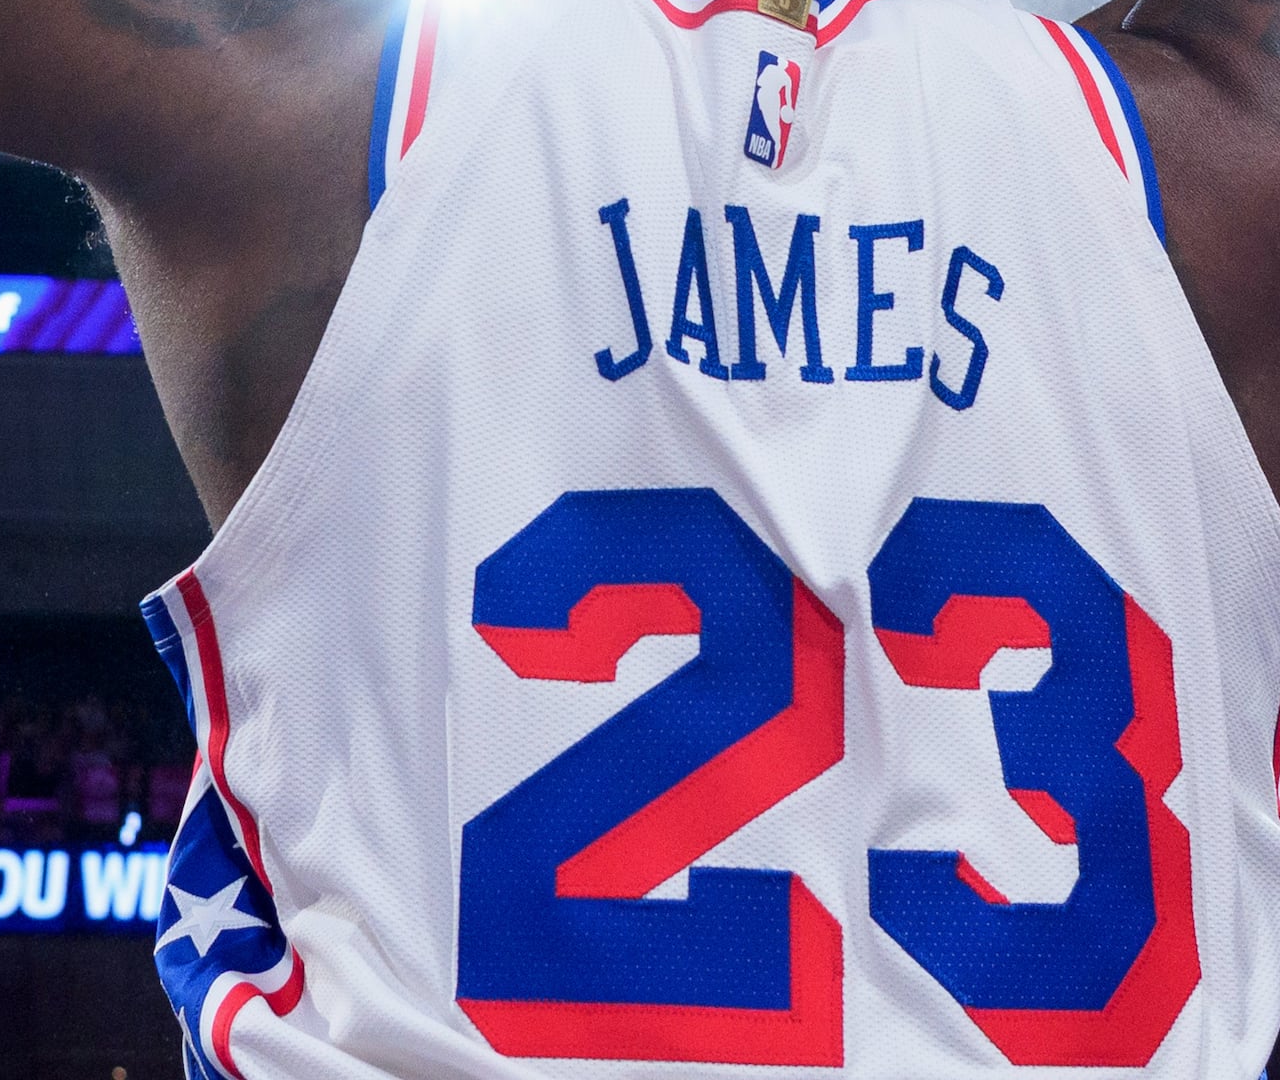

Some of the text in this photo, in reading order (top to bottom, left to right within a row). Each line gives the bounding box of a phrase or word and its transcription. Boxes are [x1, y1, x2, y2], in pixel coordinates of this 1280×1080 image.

[748, 133, 772, 161] NBA
[595, 198, 1005, 411] JAMES
[456, 487, 1202, 1067] 23
